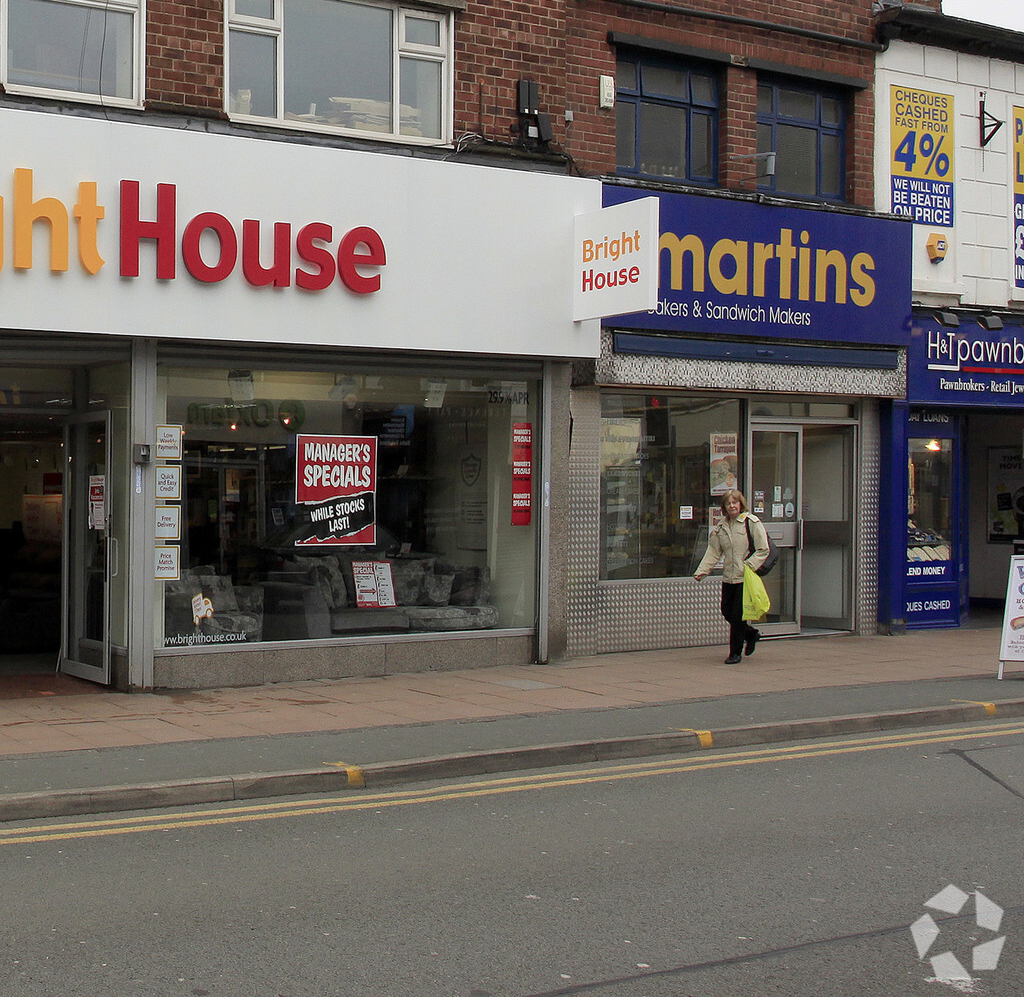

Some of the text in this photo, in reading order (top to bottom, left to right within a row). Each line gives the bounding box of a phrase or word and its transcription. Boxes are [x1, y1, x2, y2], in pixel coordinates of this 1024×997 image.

[895, 90, 948, 108] CHEQUES
[895, 103, 948, 122] CASHED
[895, 117, 949, 134] FAST FROM
[894, 130, 950, 177] 4%
[893, 178, 951, 195] WE WILL NOT
[893, 191, 951, 209] BE BEATEN
[893, 205, 951, 224] ON PRICE
[582, 230, 641, 263] Bright
[659, 228, 876, 307] martins
[582, 266, 641, 293] House
[648, 298, 811, 326] akers & Sandwich Makers
[940, 378, 985, 392] Pawnbrokers
[990, 380, 1011, 393] Retail
[713, 435, 736, 445] Chicken
[304, 442, 371, 463] MANAGER'S
[161, 473, 174, 481] Quick
[303, 464, 371, 488] SPECIALS
[310, 498, 365, 523] WHILE STOCKS
[329, 516, 351, 533] LAST!
[922, 566, 946, 575] MONEY
[923, 599, 951, 611] CASHED
